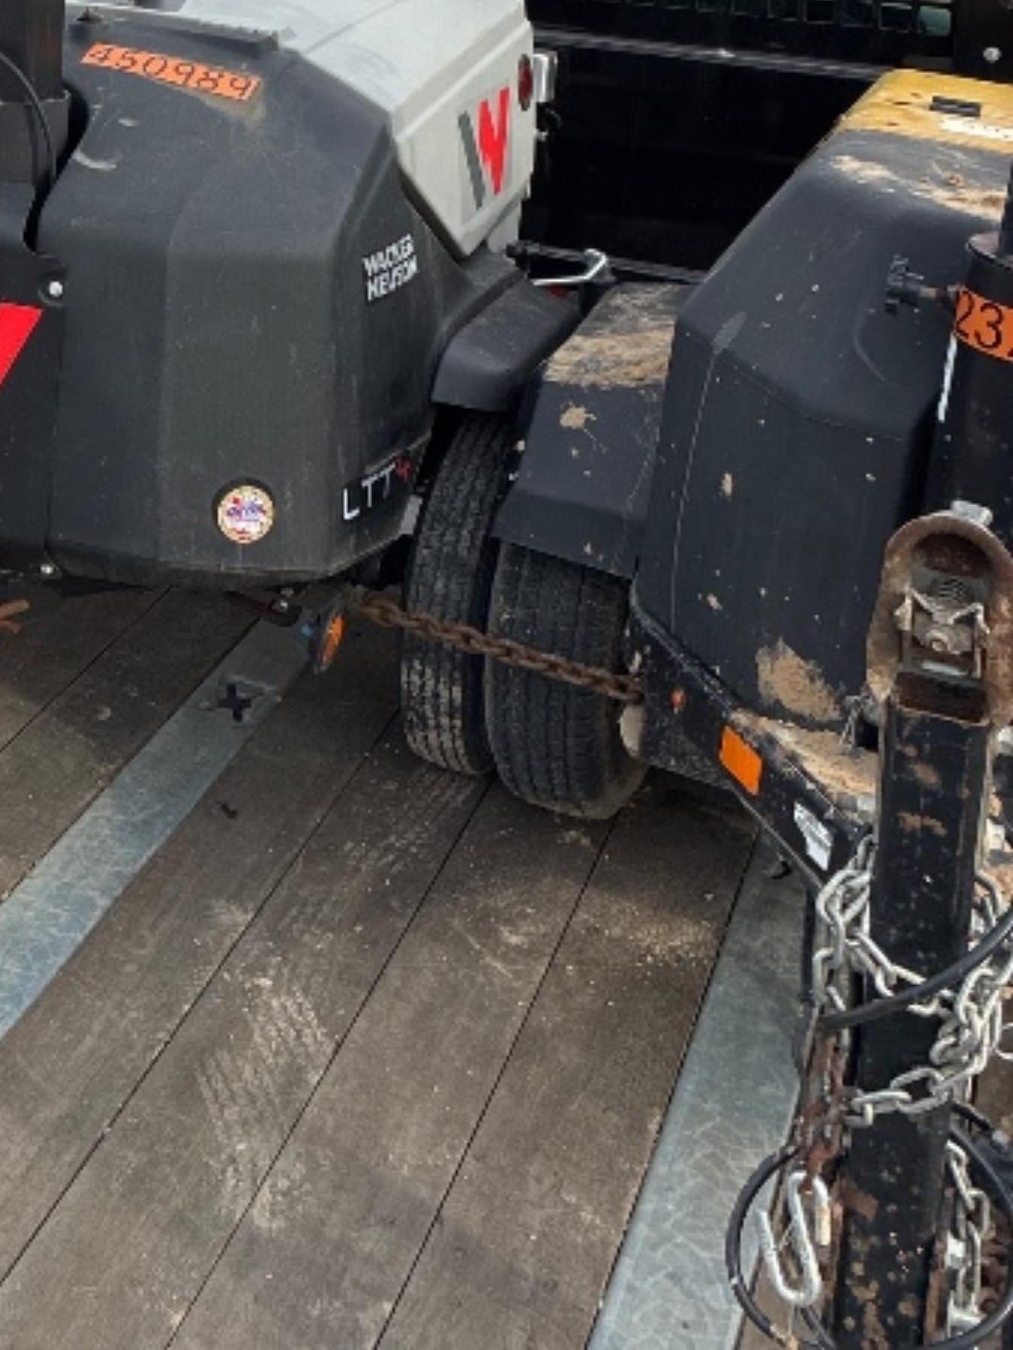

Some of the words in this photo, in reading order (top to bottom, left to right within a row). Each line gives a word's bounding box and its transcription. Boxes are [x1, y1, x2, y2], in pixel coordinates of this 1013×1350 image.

[88, 47, 252, 98] 450989
[362, 233, 415, 278] WACKER
[955, 289, 1013, 358] 23
